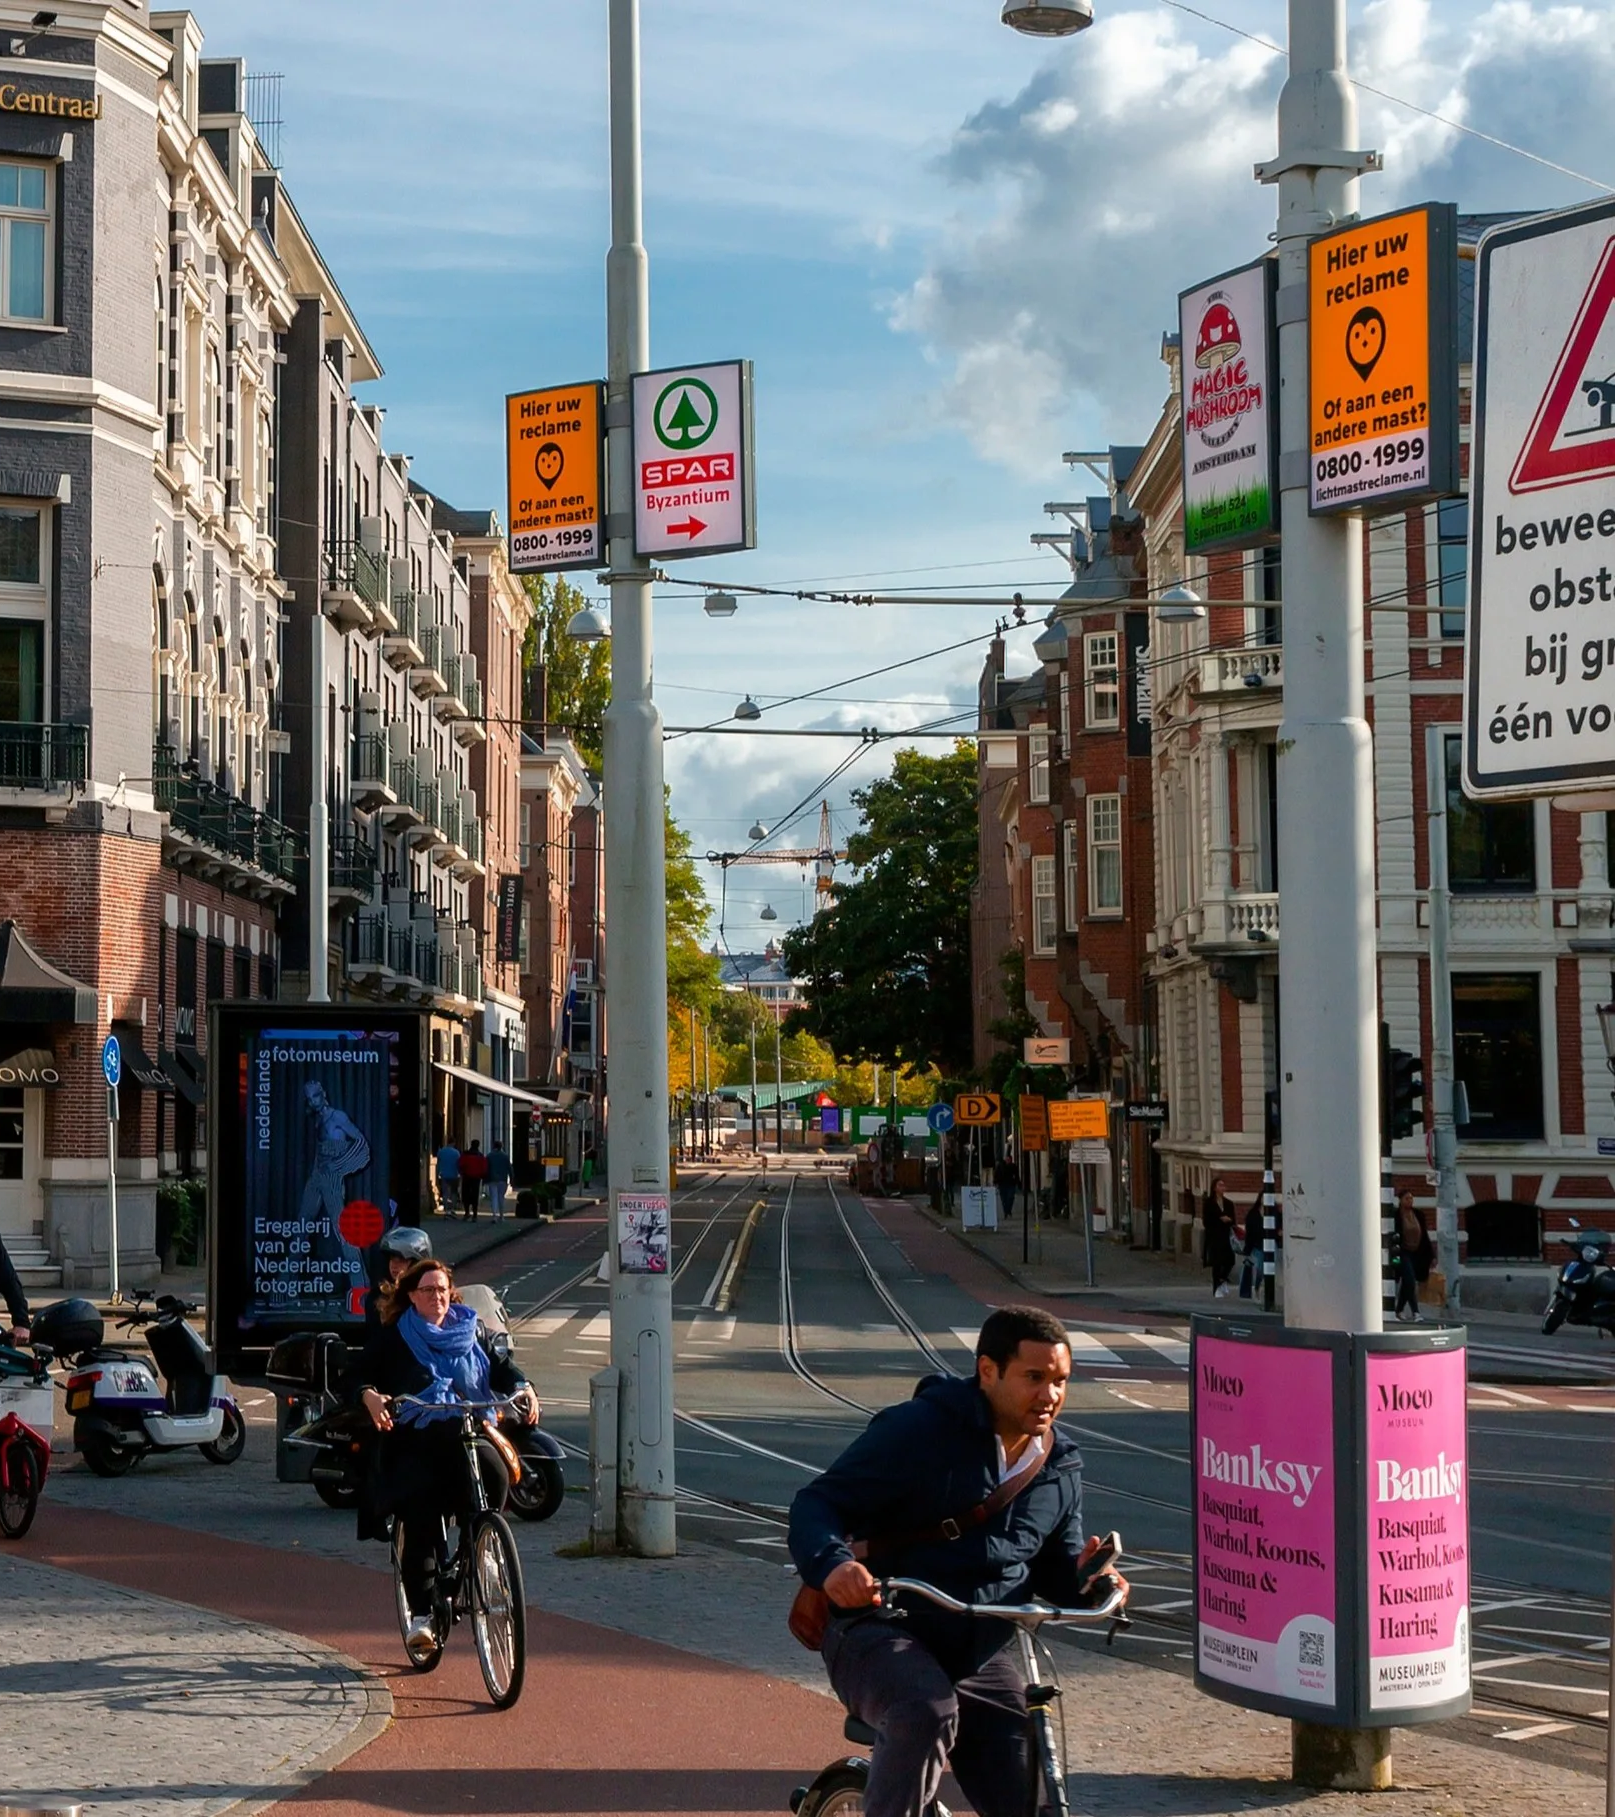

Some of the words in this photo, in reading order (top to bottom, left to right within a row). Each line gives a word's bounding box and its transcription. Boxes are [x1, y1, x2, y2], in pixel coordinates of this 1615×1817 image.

[1327, 243, 1367, 274] Hier
[1375, 232, 1408, 257] uw
[1326, 264, 1409, 306] reclame
[1191, 357, 1248, 400] MAGIC
[520, 402, 551, 419] Hier
[556, 398, 581, 413] uw
[1186, 383, 1262, 435] MUSHROOM
[1323, 401, 1340, 419] Of
[1346, 392, 1375, 412] aan
[1381, 385, 1414, 405] een
[519, 419, 582, 440] reclame
[1314, 418, 1367, 447] andere
[1373, 402, 1426, 432] mast?
[646, 458, 730, 484] SPAR
[1192, 444, 1256, 475] AMSTERDAM
[1316, 467, 1425, 502] lichtmastreclame.nl
[519, 500, 532, 513] Of
[536, 499, 557, 511] aan
[562, 495, 584, 507] een
[646, 489, 730, 513] Byzantium
[1228, 495, 1246, 513] 524
[512, 512, 552, 530] andere
[555, 507, 594, 525] mast?
[1240, 511, 1257, 528] 249
[513, 547, 594, 566] lichtmastreclame.nl
[1529, 567, 1615, 612] obst
[1525, 632, 1568, 685] bij
[1488, 701, 1553, 745] één
[1565, 704, 1615, 735] vo
[272, 1046, 380, 1064] fotomuseum
[255, 1050, 271, 1150] nederlands
[968, 1101, 981, 1117] D
[254, 1217, 330, 1238] Eregalerij
[255, 1241, 285, 1254] van
[289, 1238, 311, 1254] de
[254, 1257, 361, 1274] Nederlandse
[255, 1276, 334, 1297] fotografie
[1203, 1364, 1244, 1398] Moco
[1377, 1384, 1433, 1412] Moco
[1201, 1437, 1323, 1508] Banksy
[1376, 1451, 1463, 1505] Banksy
[1202, 1491, 1264, 1528] Basquiat,
[1203, 1523, 1253, 1559] Warhol,
[1256, 1536, 1326, 1572] Koons,
[1378, 1544, 1442, 1572] Warhol,
[1203, 1555, 1257, 1590] Kusama
[1260, 1571, 1277, 1594] &
[1203, 1587, 1247, 1625] Haring
[1379, 1582, 1443, 1607] Kusama
[1446, 1577, 1454, 1597] &
[1379, 1612, 1438, 1640] Haring
[1203, 1635, 1258, 1664] MUSEUMPLEIN
[1379, 1660, 1446, 1681] MUSEUMPLEIN
